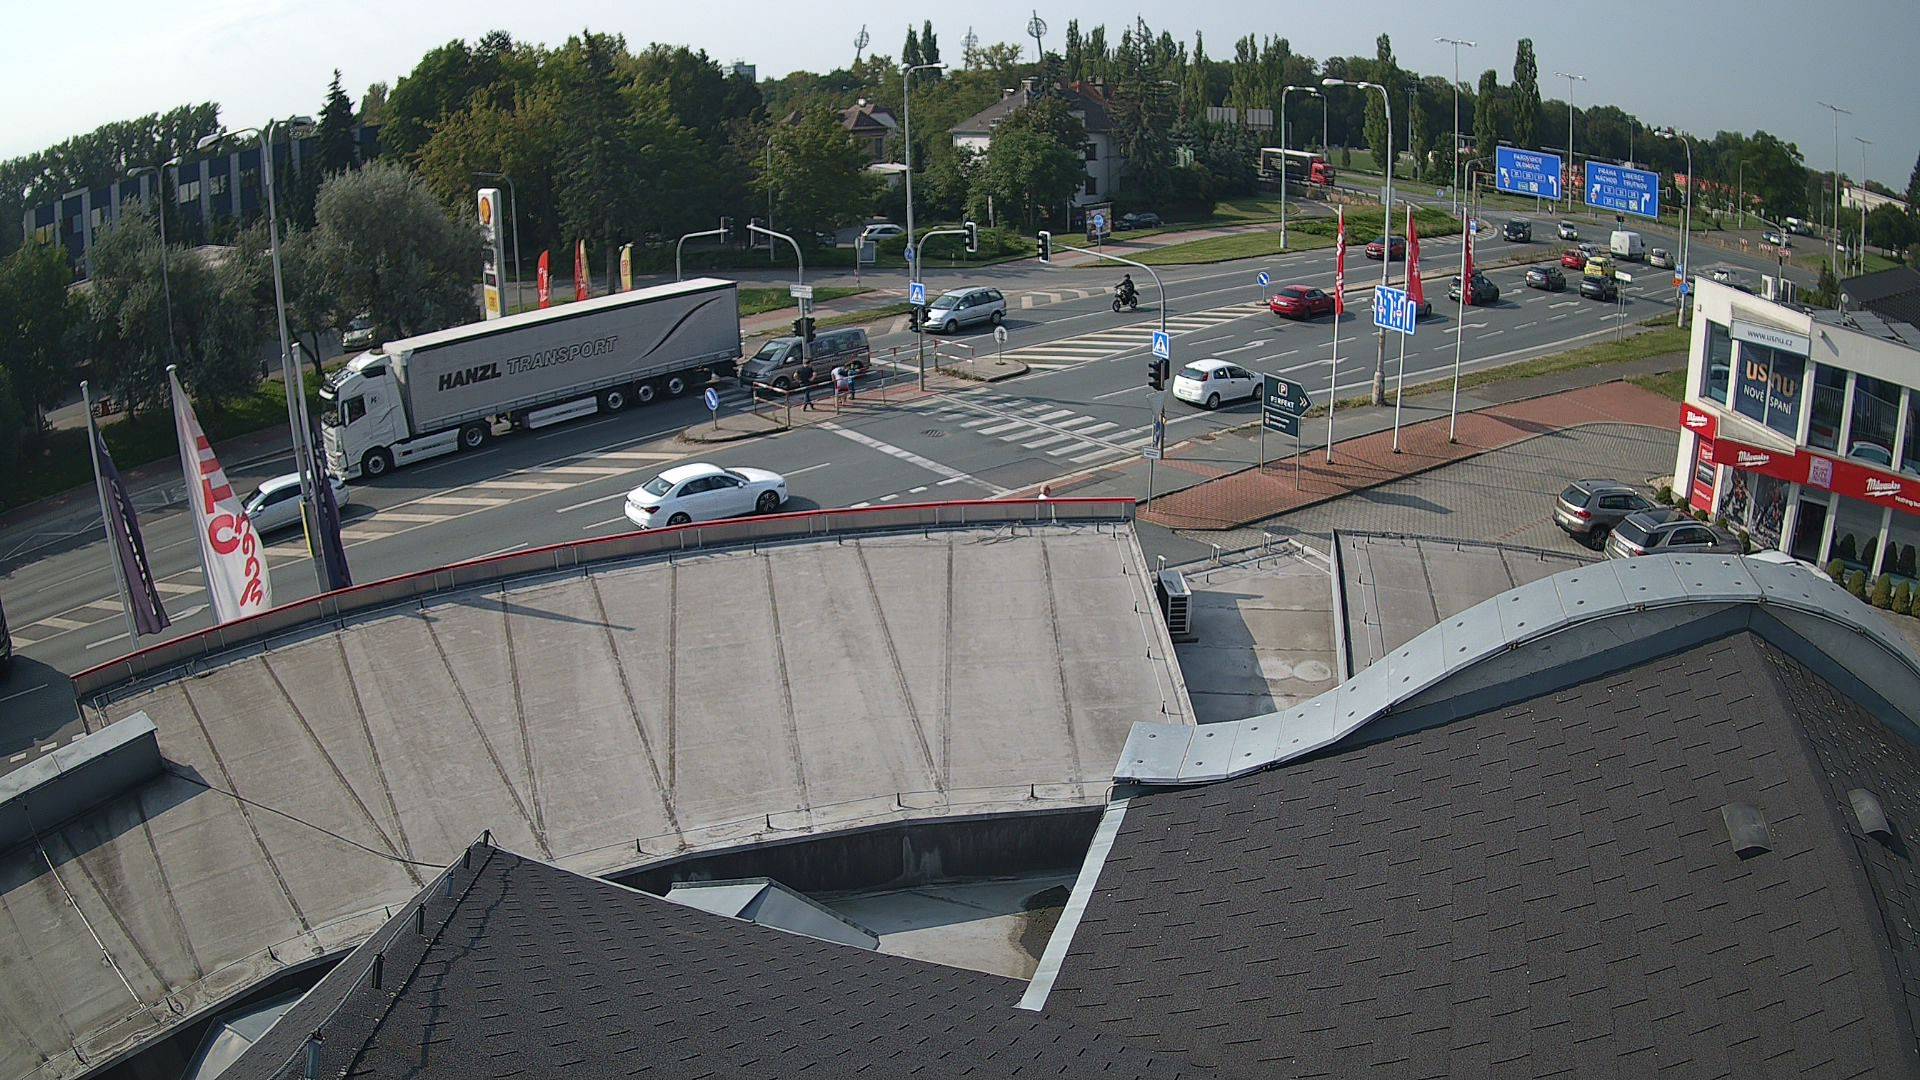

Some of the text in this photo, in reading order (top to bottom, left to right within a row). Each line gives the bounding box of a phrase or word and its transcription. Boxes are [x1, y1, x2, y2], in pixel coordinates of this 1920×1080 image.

[438, 336, 618, 392] HANZL TRANSPORT
[1743, 384, 1793, 416] NOVÉ SPANÍ
